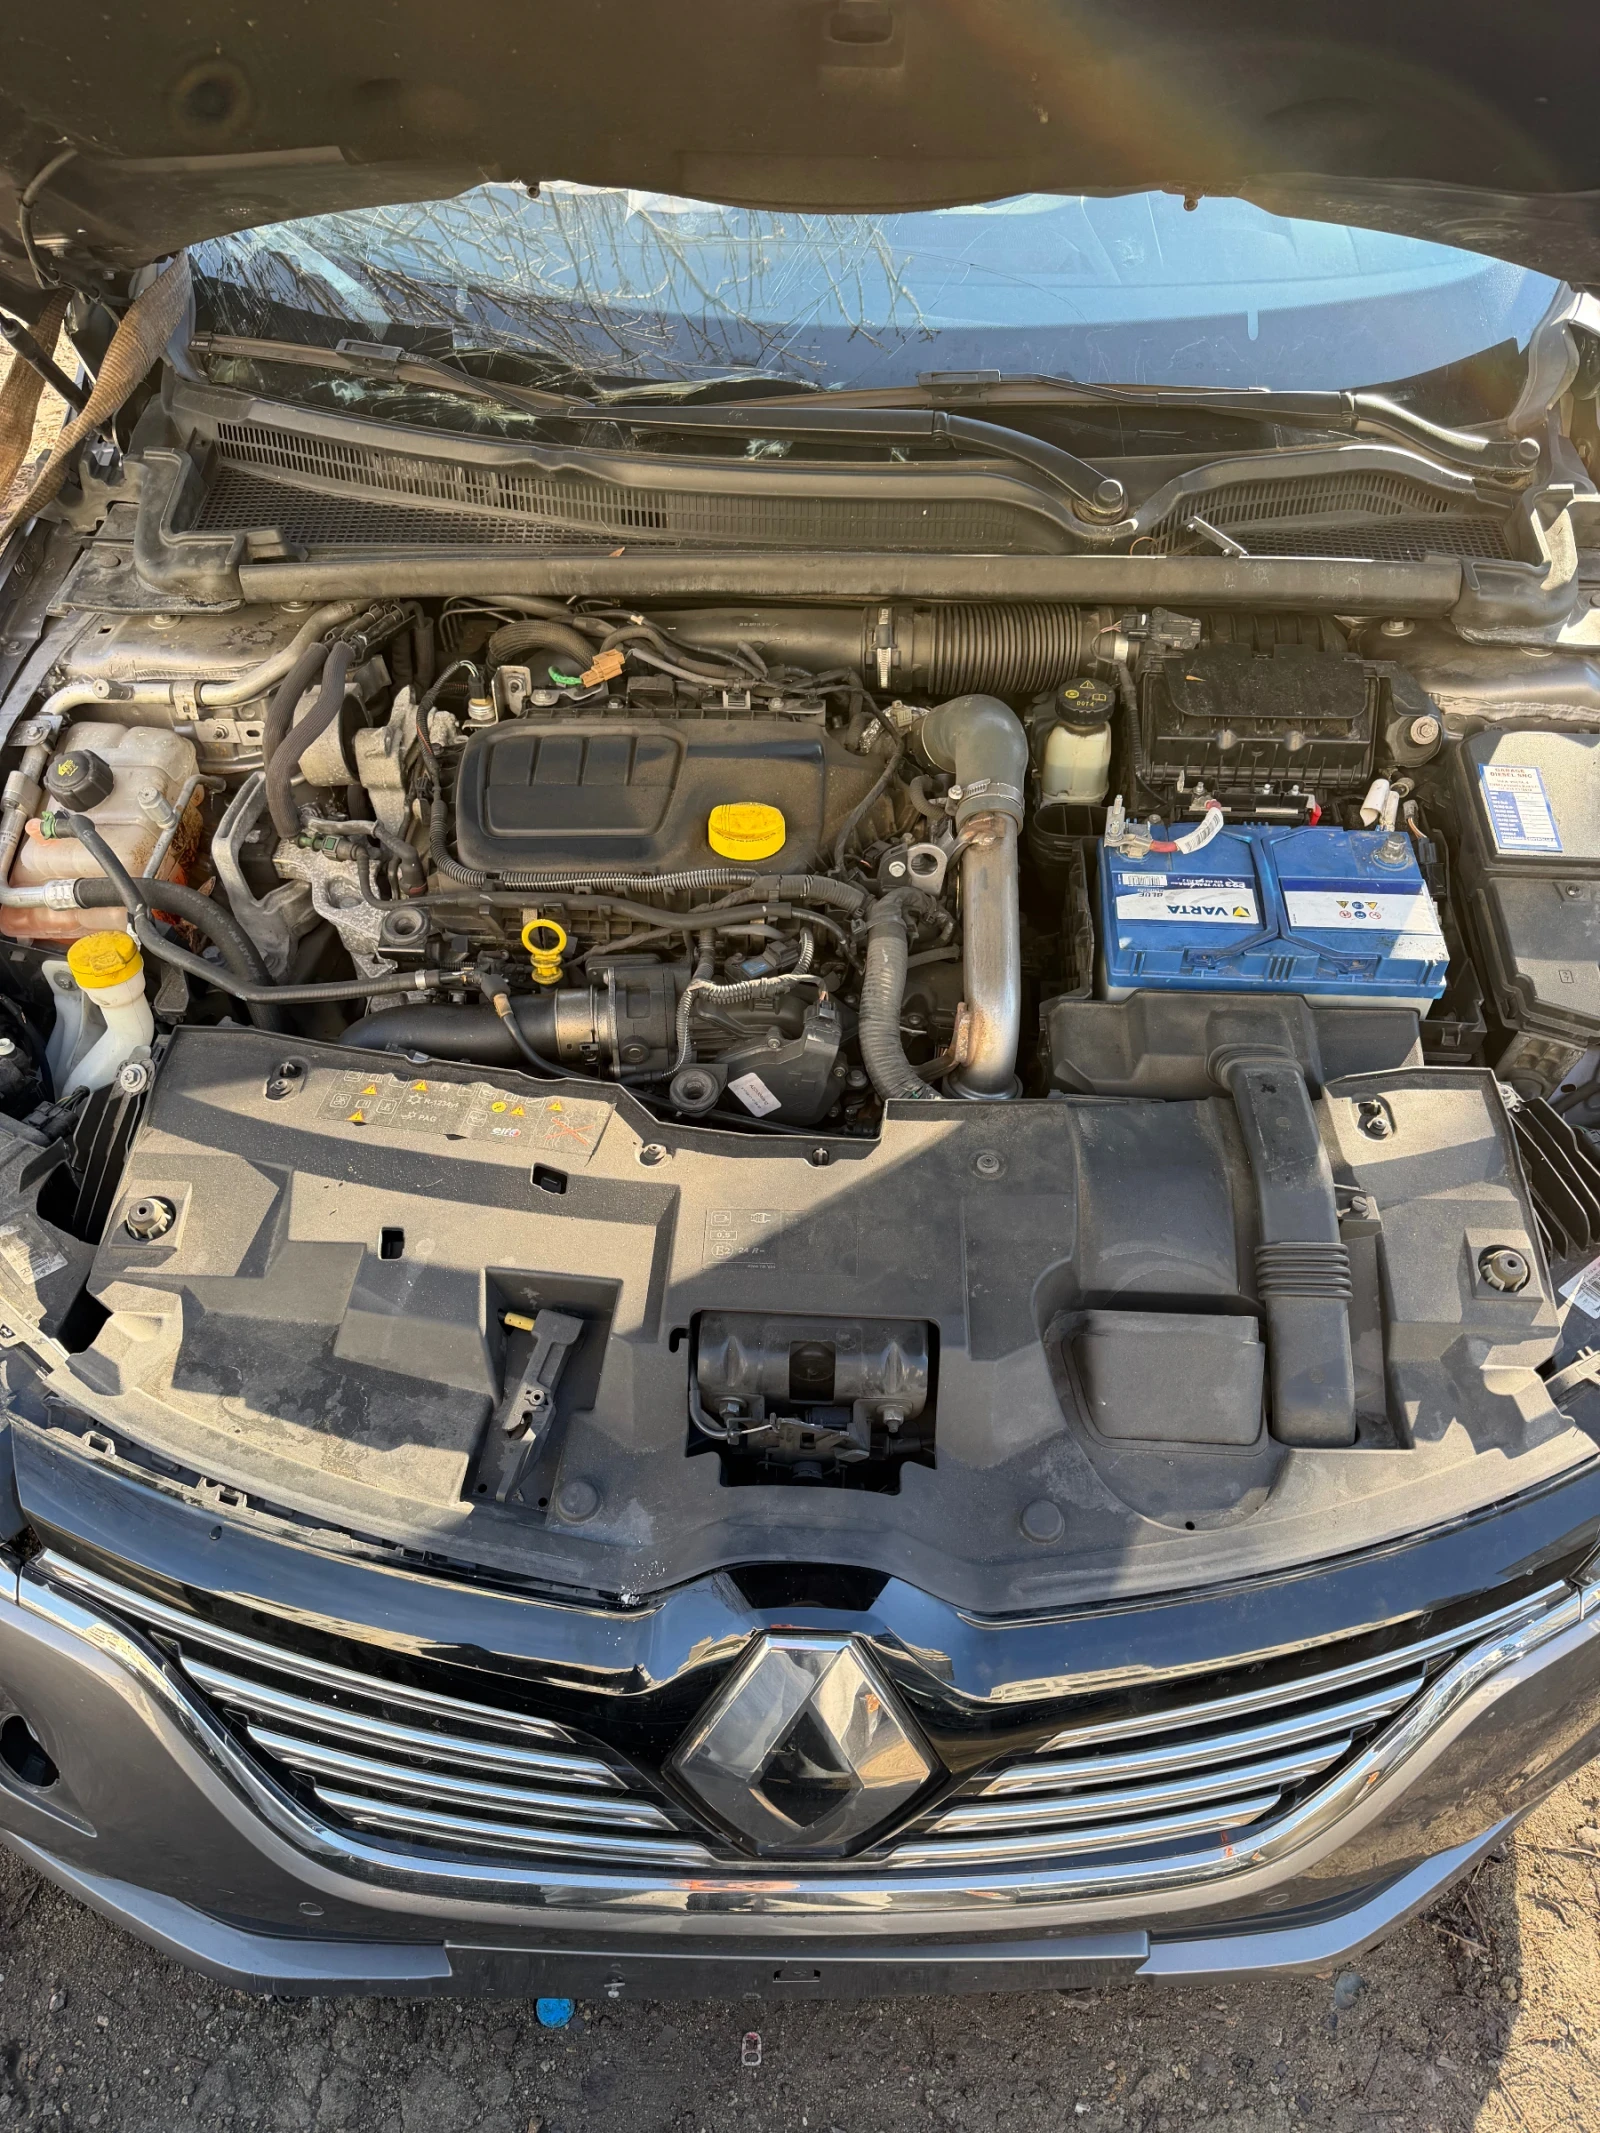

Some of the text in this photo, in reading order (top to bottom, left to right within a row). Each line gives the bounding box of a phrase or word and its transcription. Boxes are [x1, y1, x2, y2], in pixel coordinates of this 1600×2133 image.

[1167, 904, 1228, 916] VARTA
[424, 1098, 459, 1108] R-1234yf
[418, 1114, 437, 1122] PAG
[491, 1127, 511, 1137] elf
[716, 1231, 731, 1239] 0,5
[715, 1245, 731, 1256] E2
